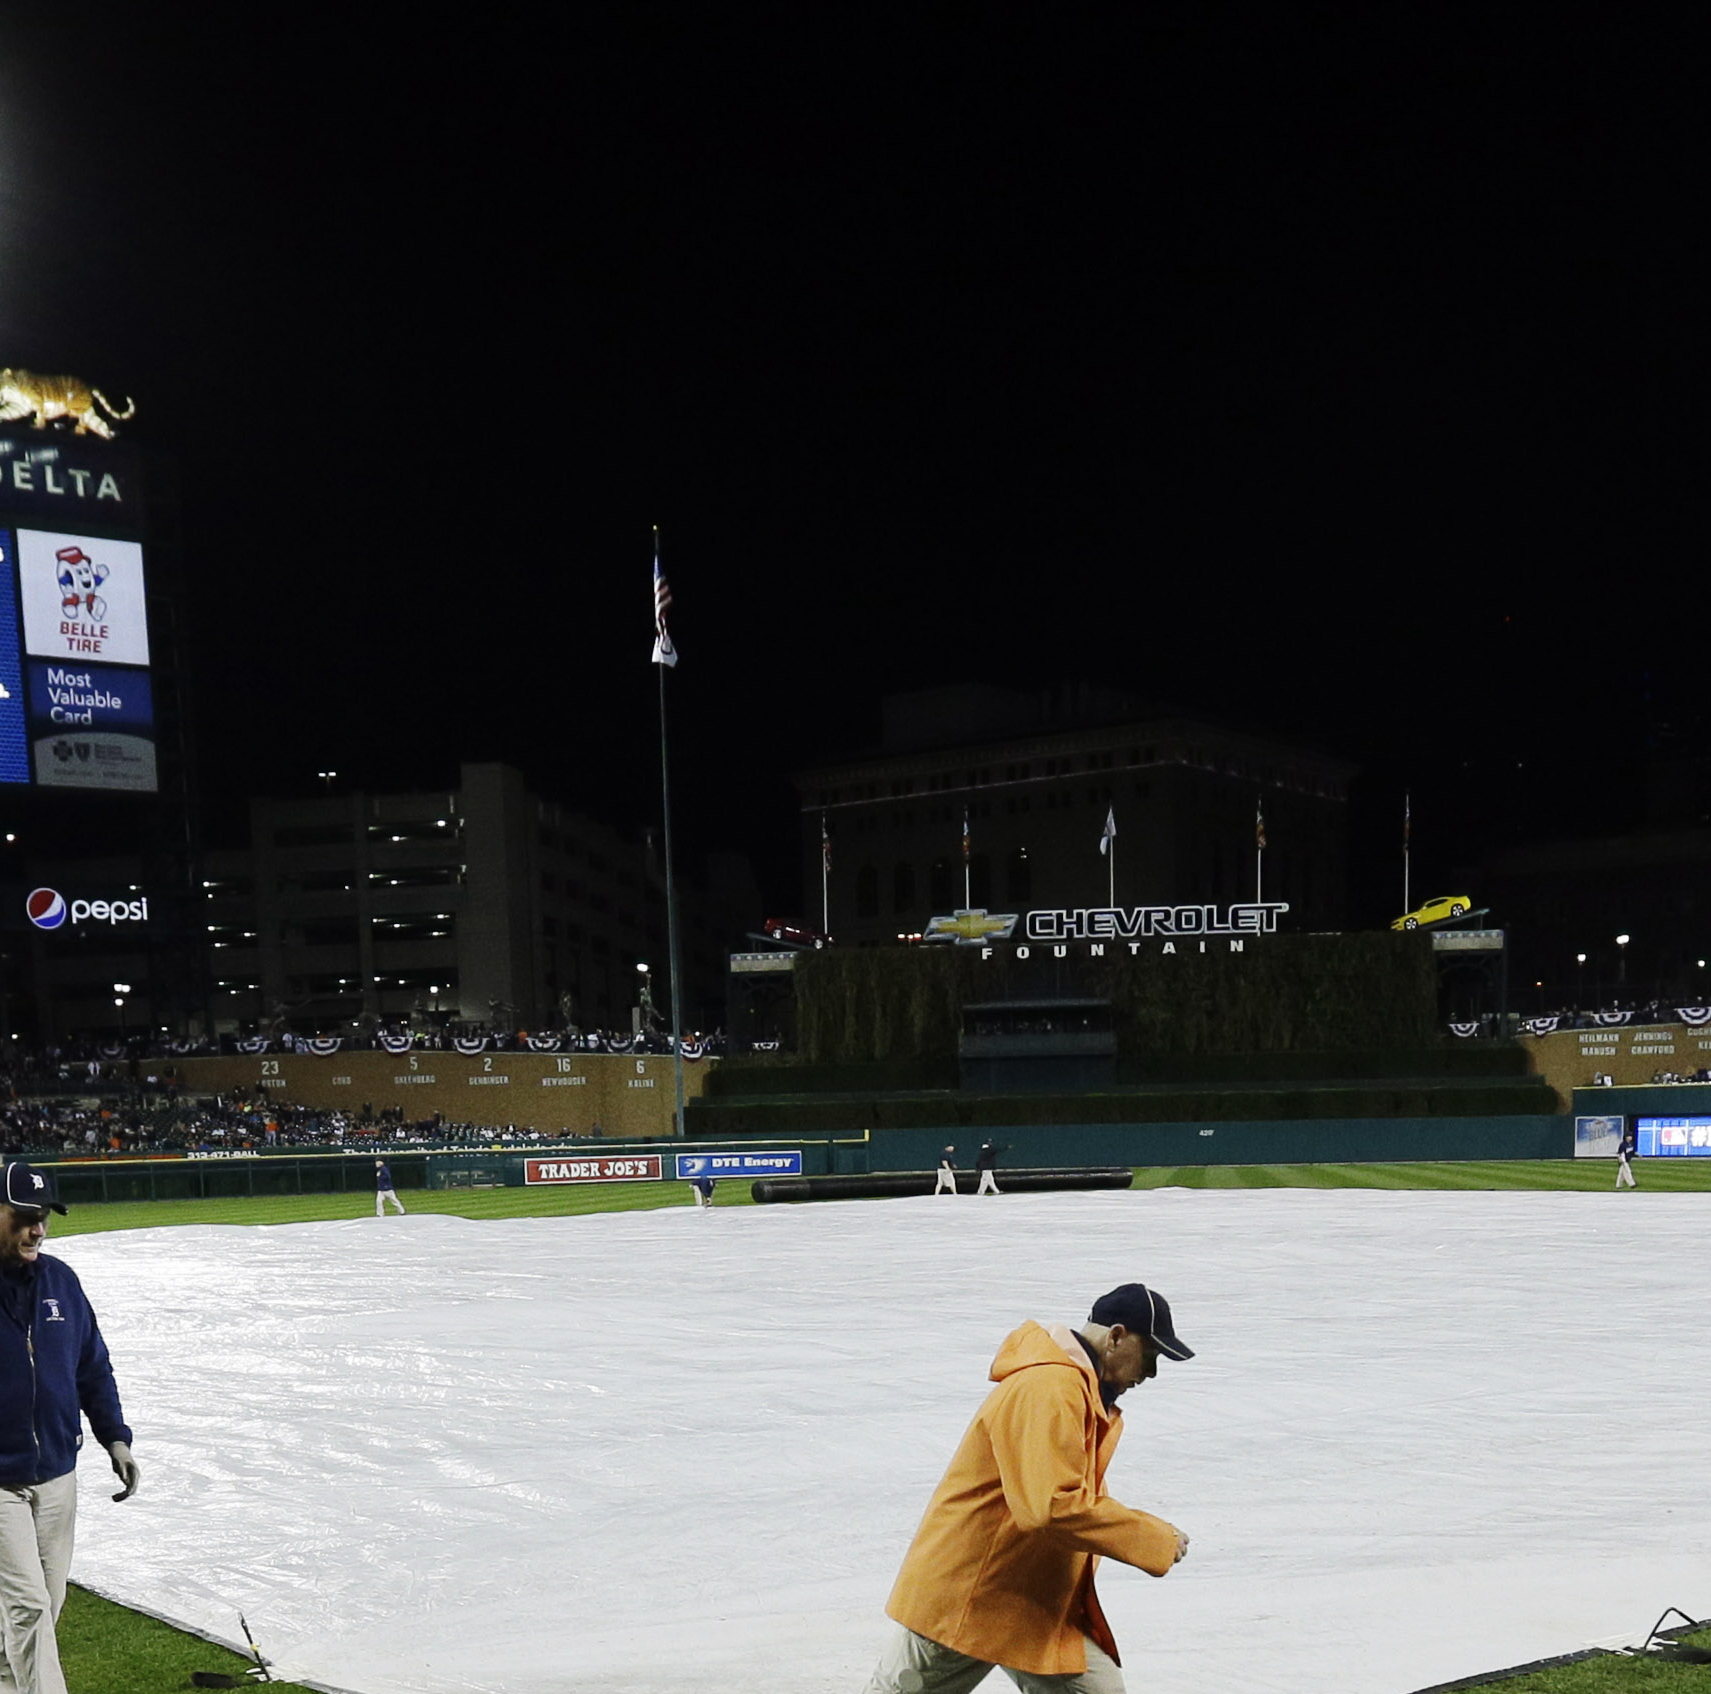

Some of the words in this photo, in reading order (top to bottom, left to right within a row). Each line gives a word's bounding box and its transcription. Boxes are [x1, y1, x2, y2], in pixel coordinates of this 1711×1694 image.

[59, 621, 110, 640] BELLE
[65, 637, 102, 653] TIRE
[47, 667, 93, 688] Most
[47, 687, 123, 709] Valuable
[50, 706, 93, 725] Card
[70, 896, 148, 925] pepsi
[1026, 902, 1289, 940] CHEVROLET
[981, 938, 1244, 961] FOUNTAIN
[261, 1061, 279, 1075] 23
[409, 1056, 418, 1071] 5
[483, 1058, 493, 1072] 2
[556, 1058, 571, 1073] 16
[636, 1060, 645, 1074] 6
[539, 1162, 601, 1179] TRADER
[603, 1160, 649, 1176] JOE'S
[711, 1157, 740, 1168] DTE
[744, 1155, 794, 1168] Energy
